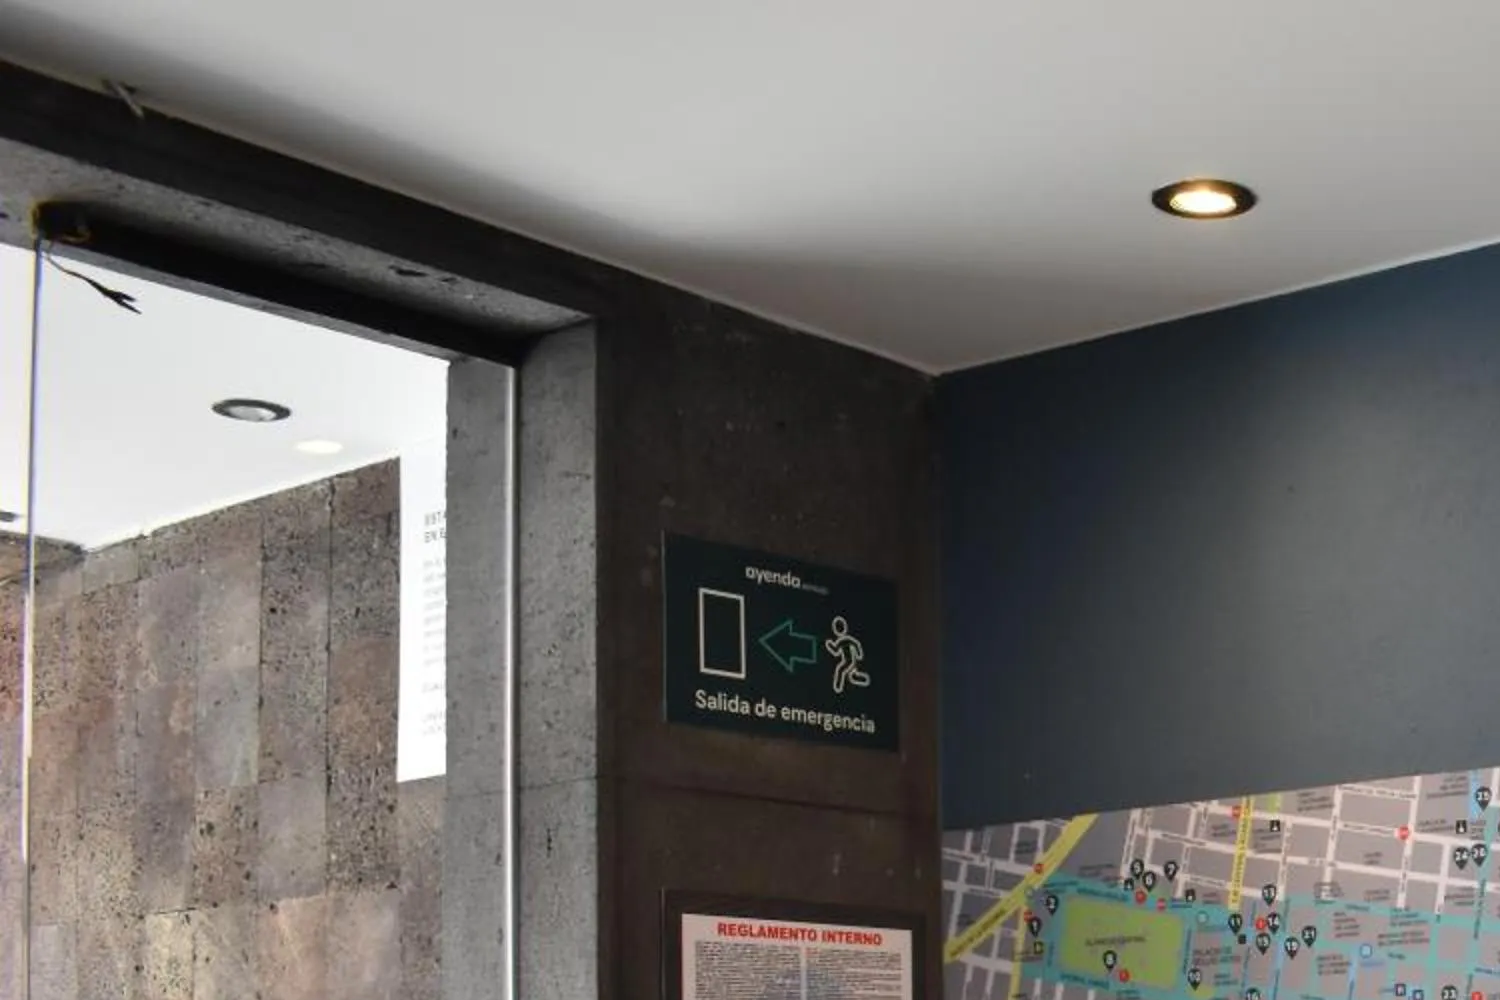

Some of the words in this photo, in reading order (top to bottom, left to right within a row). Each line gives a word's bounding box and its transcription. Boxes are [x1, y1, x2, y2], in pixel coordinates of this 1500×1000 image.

[746, 566, 801, 589] ayenda
[695, 689, 750, 715] Salida
[755, 698, 777, 718] de
[781, 706, 875, 733] emergencia
[717, 922, 817, 942] REGLAMENTO
[821, 930, 883, 946] INTERNO
